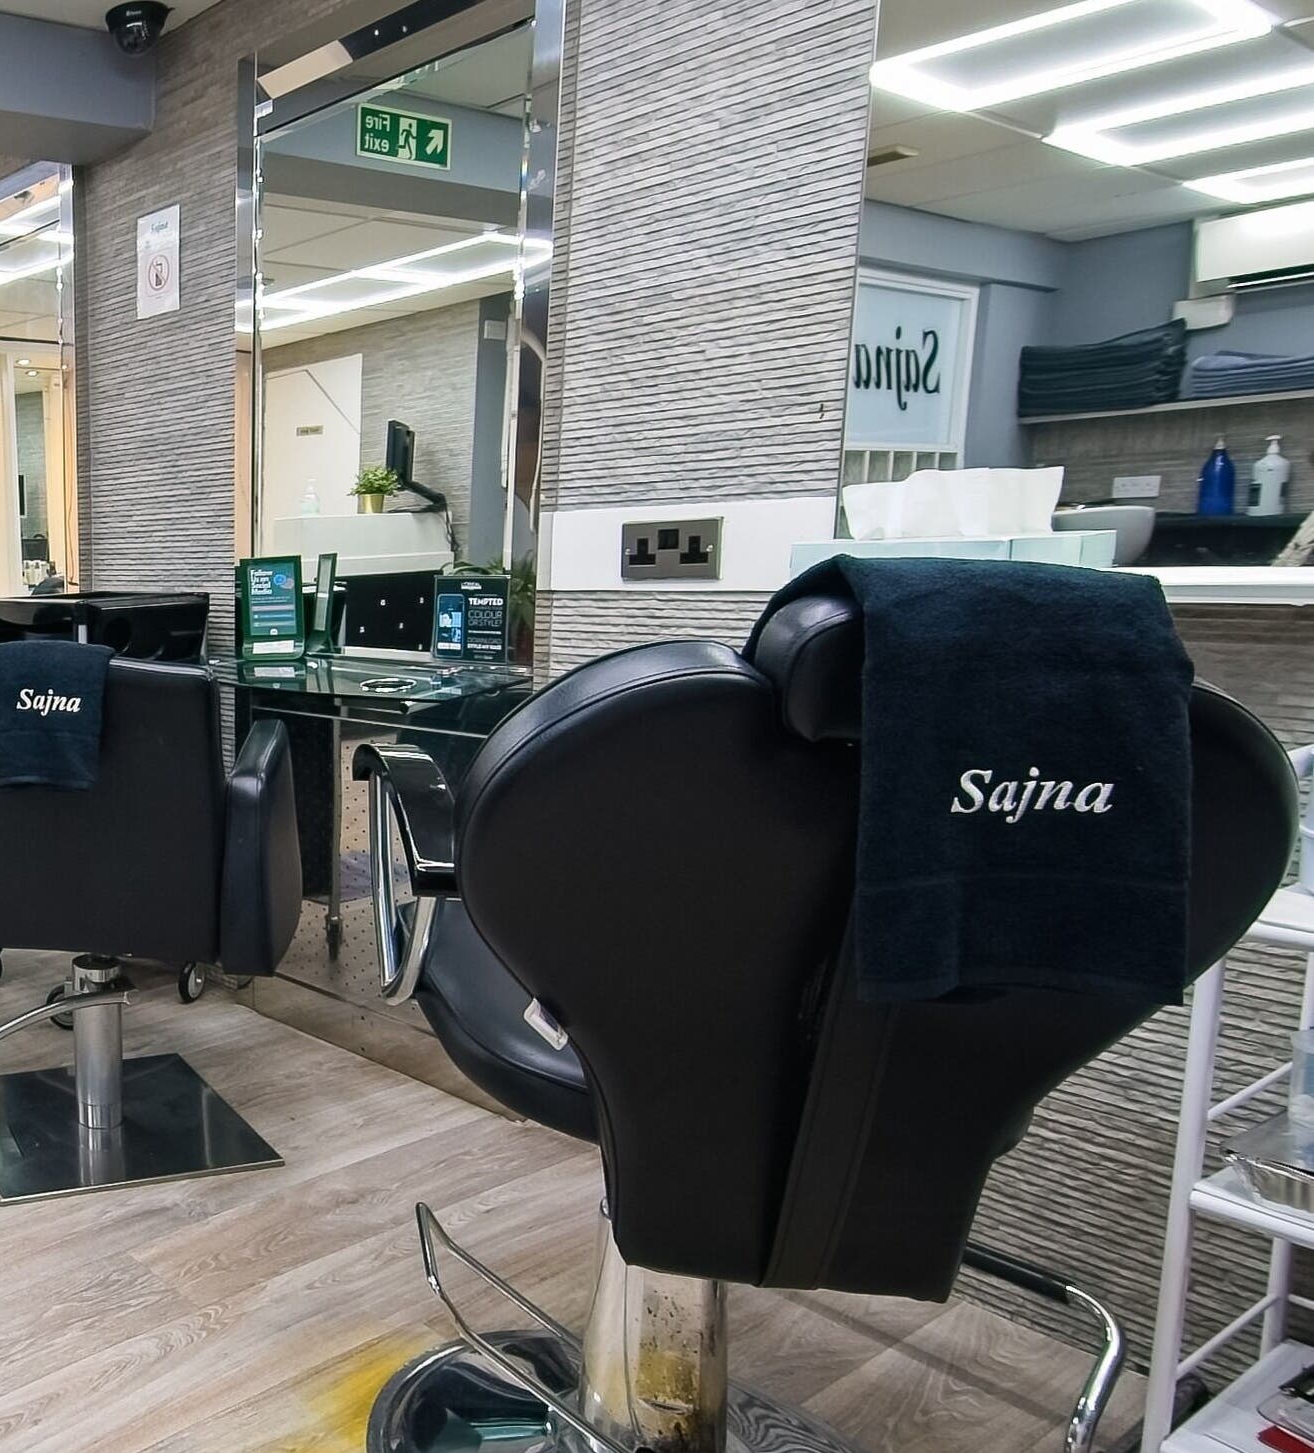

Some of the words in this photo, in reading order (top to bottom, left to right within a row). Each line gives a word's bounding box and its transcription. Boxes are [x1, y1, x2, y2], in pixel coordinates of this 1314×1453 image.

[468, 597, 504, 606] TEMPTED
[467, 610, 503, 619] COLOUR
[16, 688, 82, 717] Sajna
[950, 766, 1115, 824] Sajna
